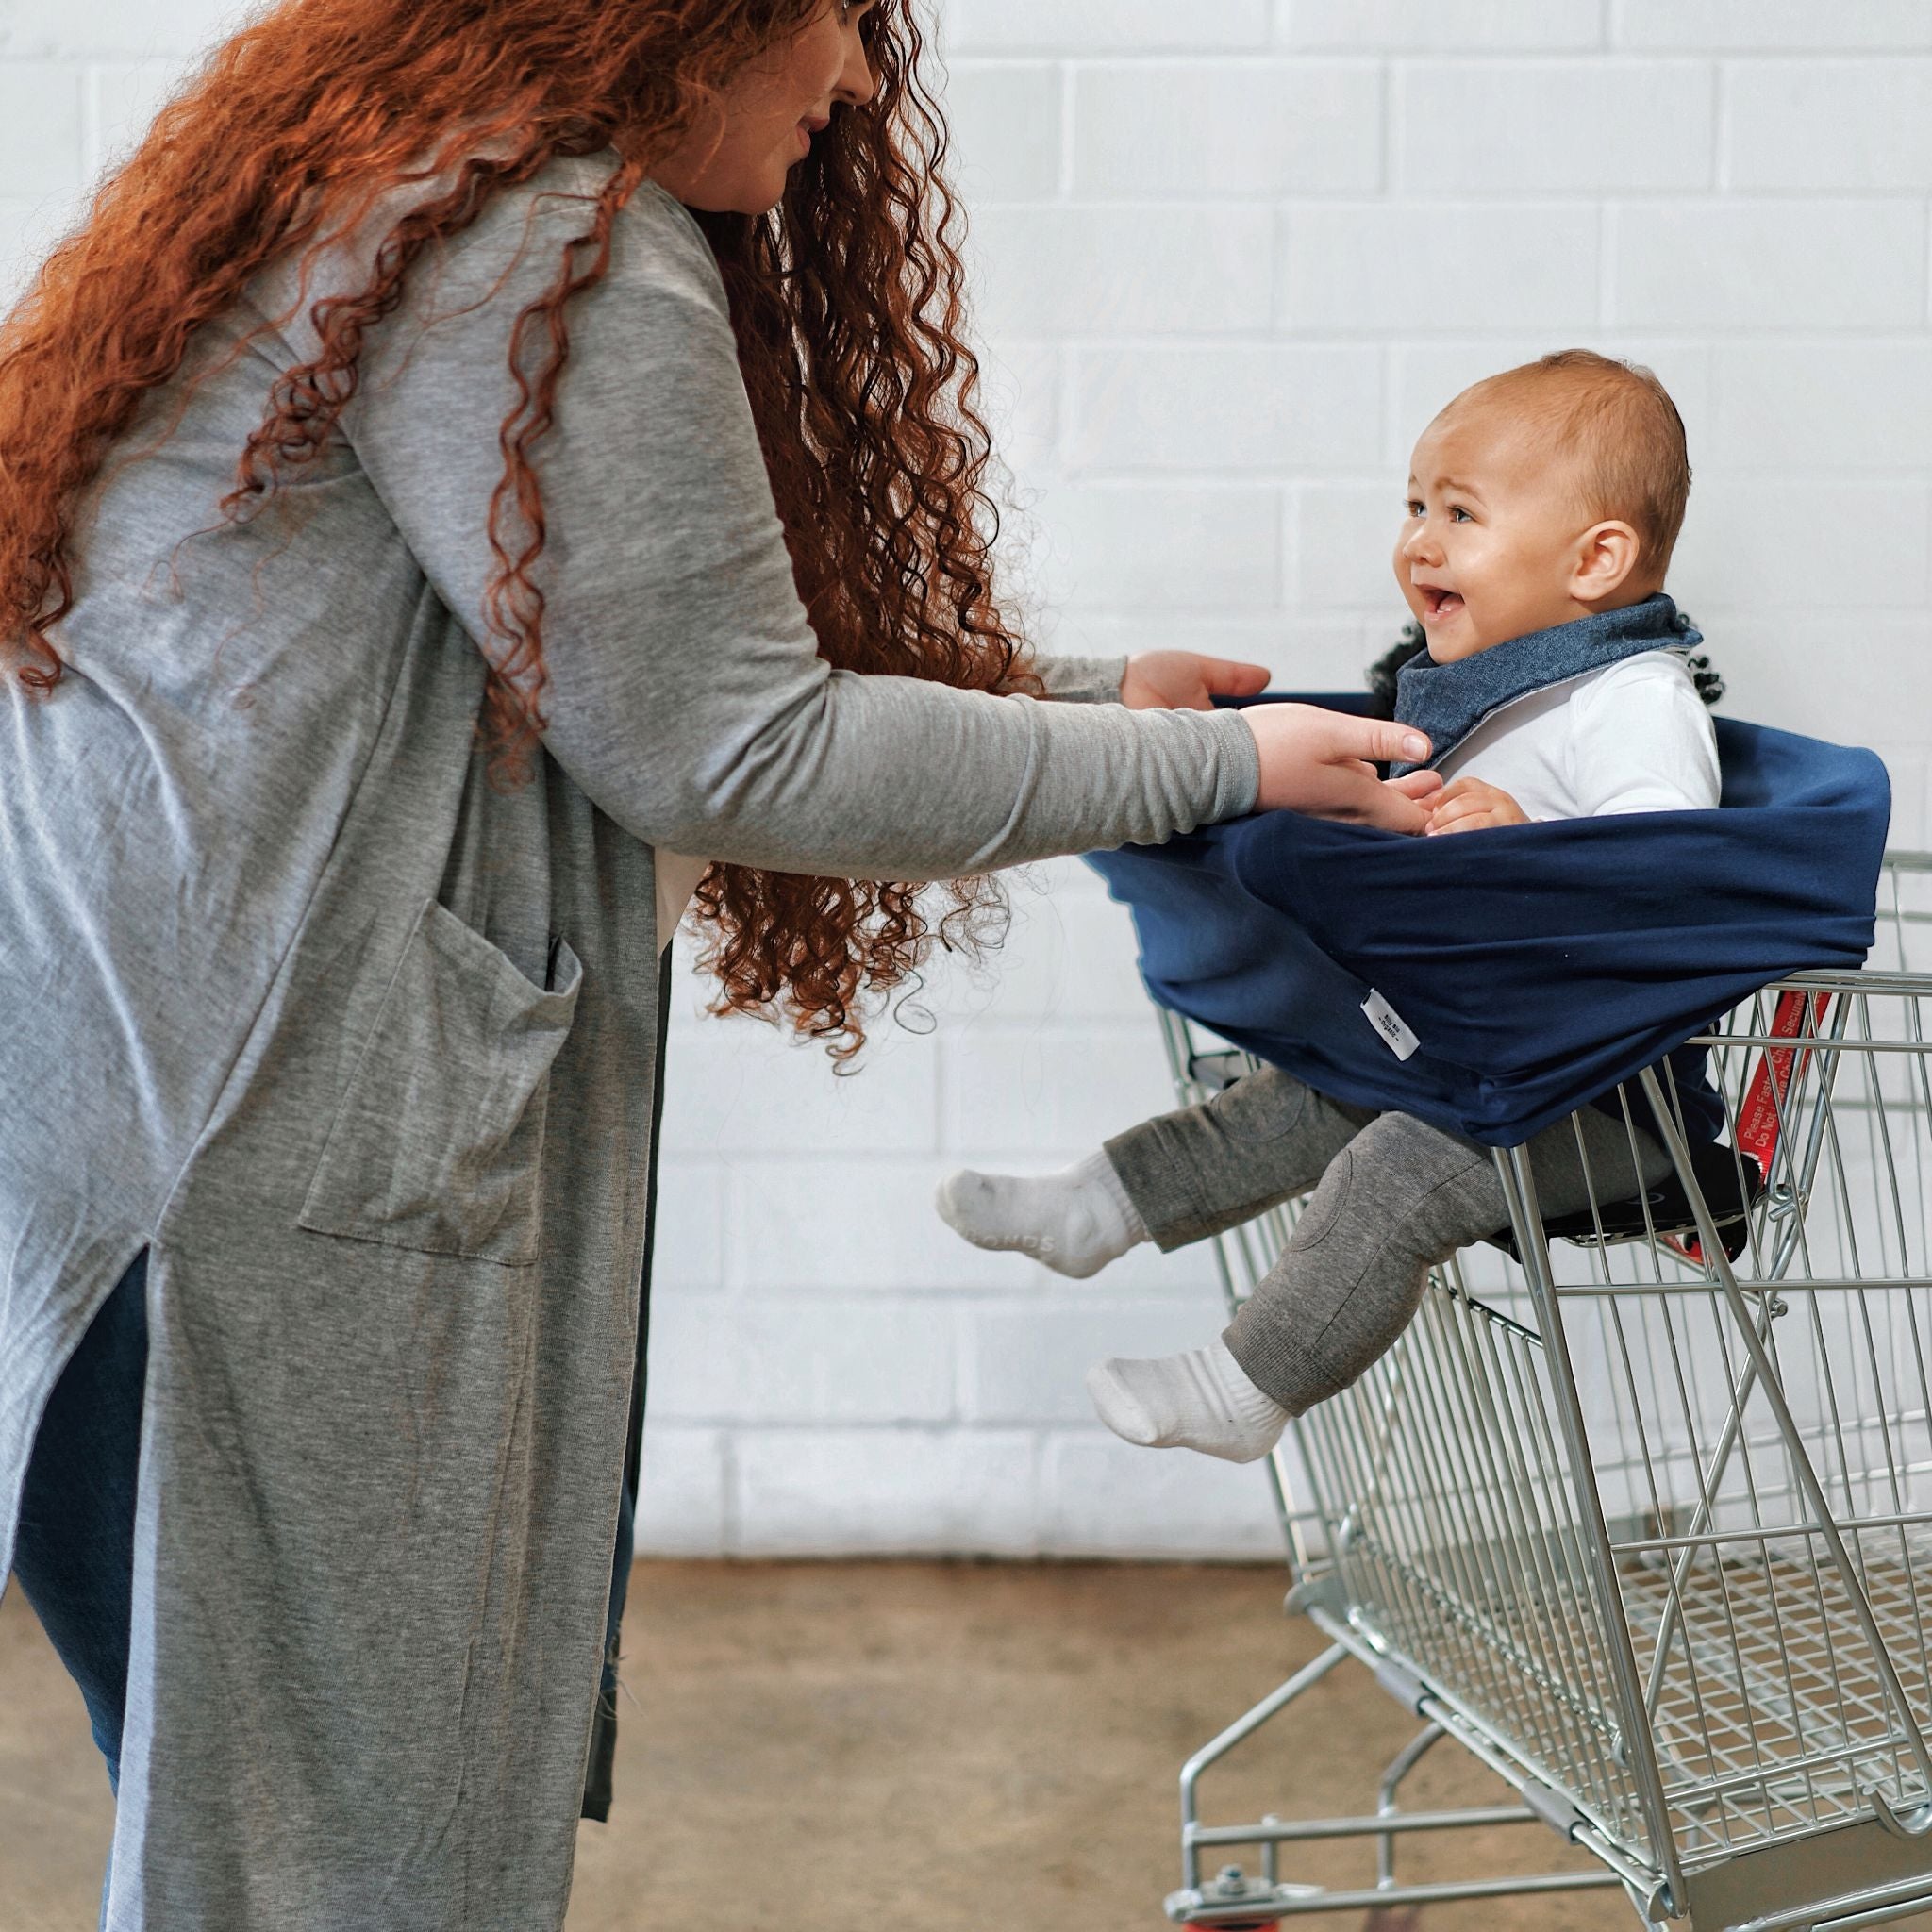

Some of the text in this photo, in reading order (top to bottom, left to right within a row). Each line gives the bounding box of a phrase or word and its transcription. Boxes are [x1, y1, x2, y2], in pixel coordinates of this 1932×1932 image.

[1743, 1106, 1765, 1141] Please
[1761, 1111, 1777, 1131] Not
[1754, 1132, 1770, 1148] Do
